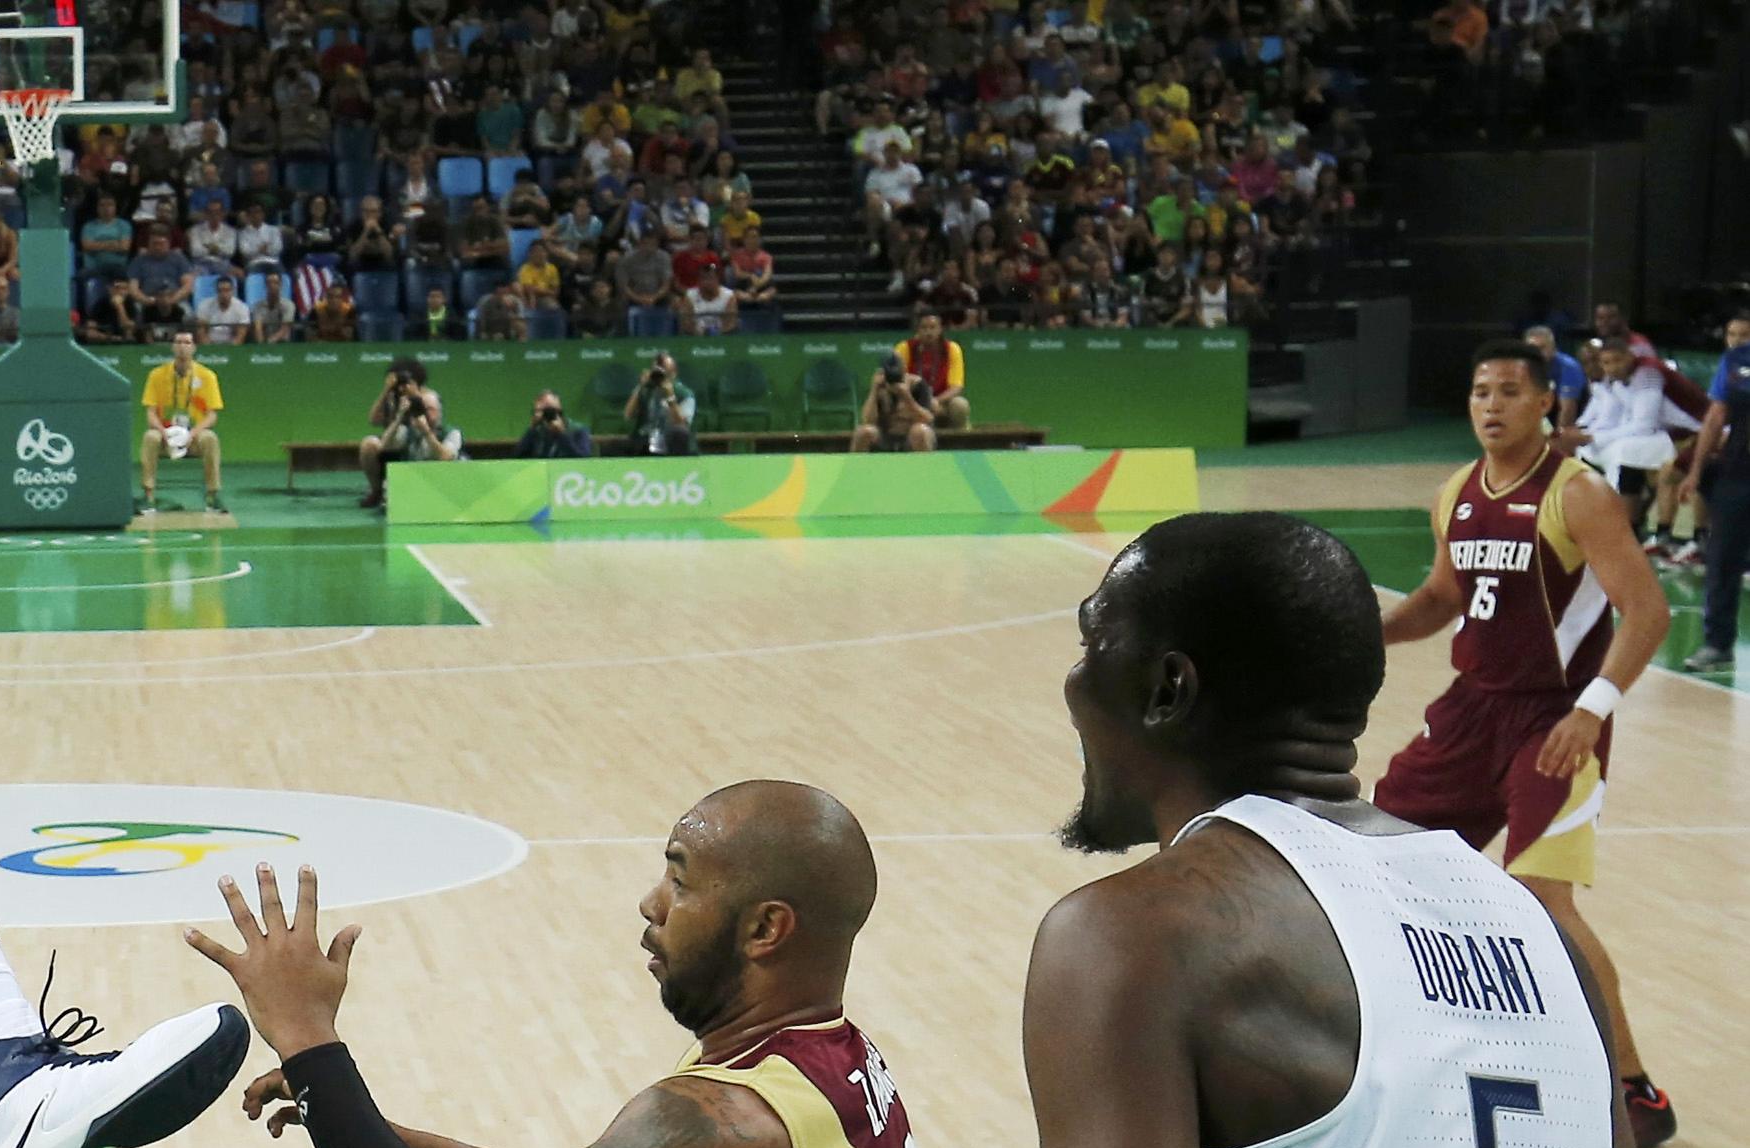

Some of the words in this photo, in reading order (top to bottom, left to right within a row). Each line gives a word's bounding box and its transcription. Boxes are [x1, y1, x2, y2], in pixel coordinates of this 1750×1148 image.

[13, 467, 78, 485] Rio2016
[554, 471, 705, 507] Rio2016
[1469, 576, 1499, 620] 15
[1400, 921, 1548, 1015] DURANT
